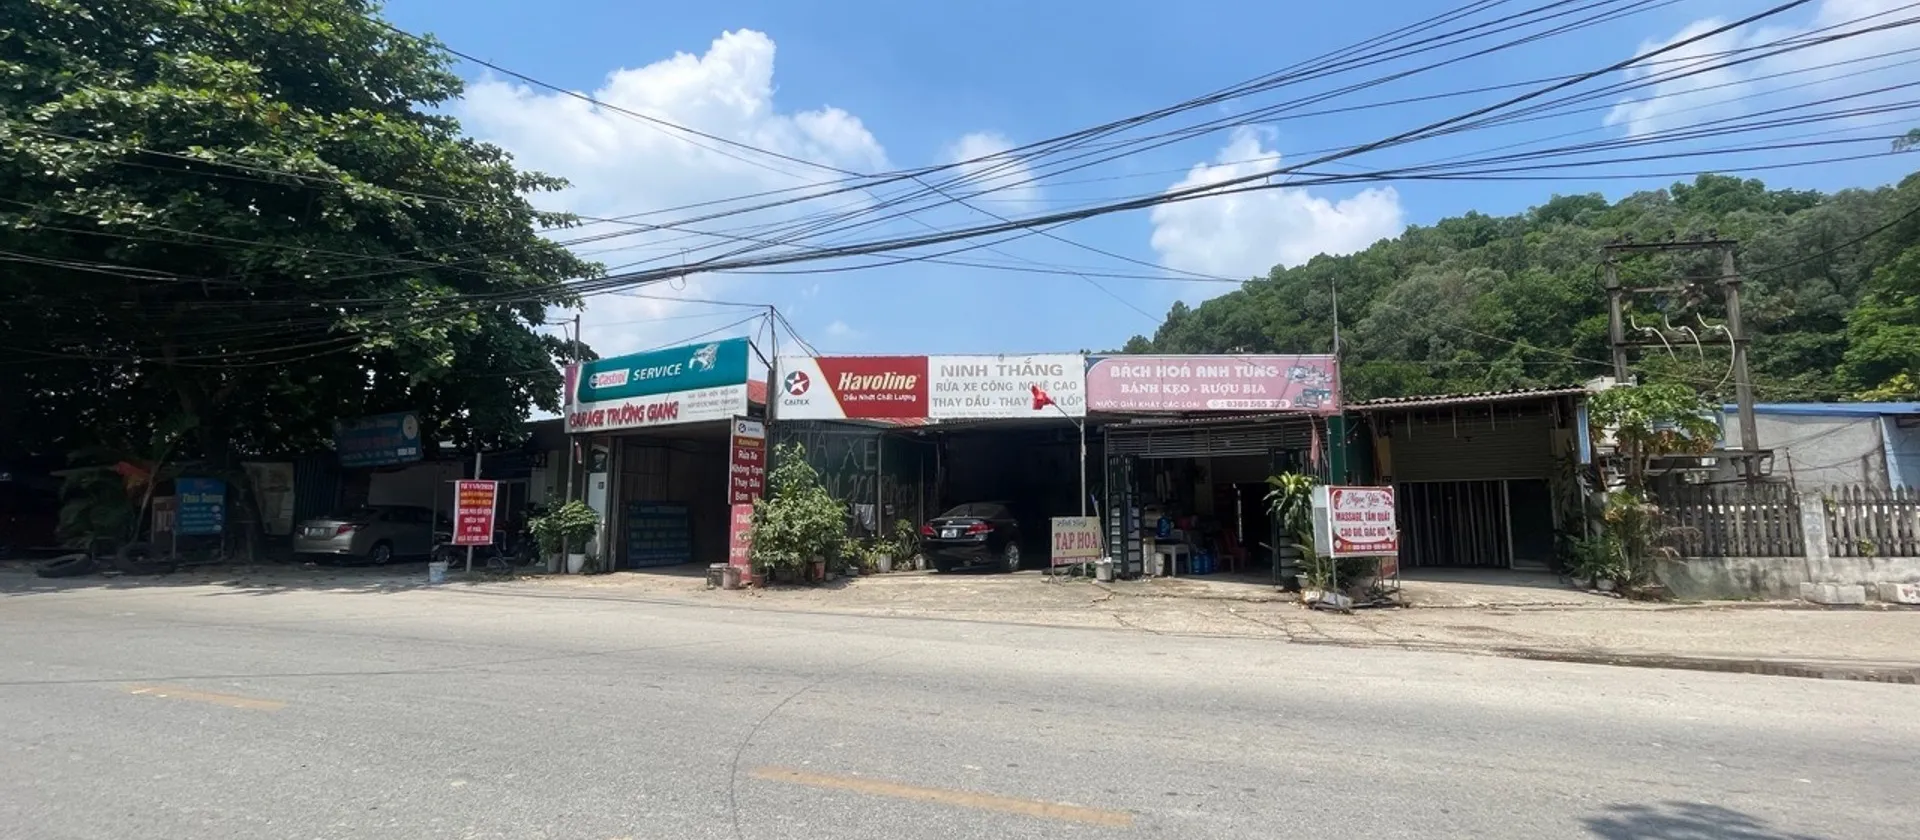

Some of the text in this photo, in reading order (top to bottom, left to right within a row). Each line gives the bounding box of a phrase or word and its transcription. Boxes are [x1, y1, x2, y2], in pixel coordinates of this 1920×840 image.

[633, 363, 682, 381] SERVICE
[941, 357, 1063, 378] NINH THẮNG
[1110, 362, 1151, 378] BÁCH
[1156, 361, 1190, 378] HOÁ
[1196, 365, 1229, 378] ANH
[838, 372, 917, 391] Havoline
[936, 378, 959, 392] RỬA
[963, 382, 978, 392] XE
[981, 380, 1013, 392] CÔNG
[1053, 381, 1077, 391] CAO
[1121, 381, 1158, 394] BÁNH
[1162, 384, 1189, 396] KẸO
[1243, 384, 1267, 394] BIA
[784, 398, 810, 406] CALTEX
[933, 397, 962, 408] THAY
[999, 396, 1028, 406] THAY
[570, 409, 604, 428] GARAGE
[647, 401, 679, 422] GIANG
